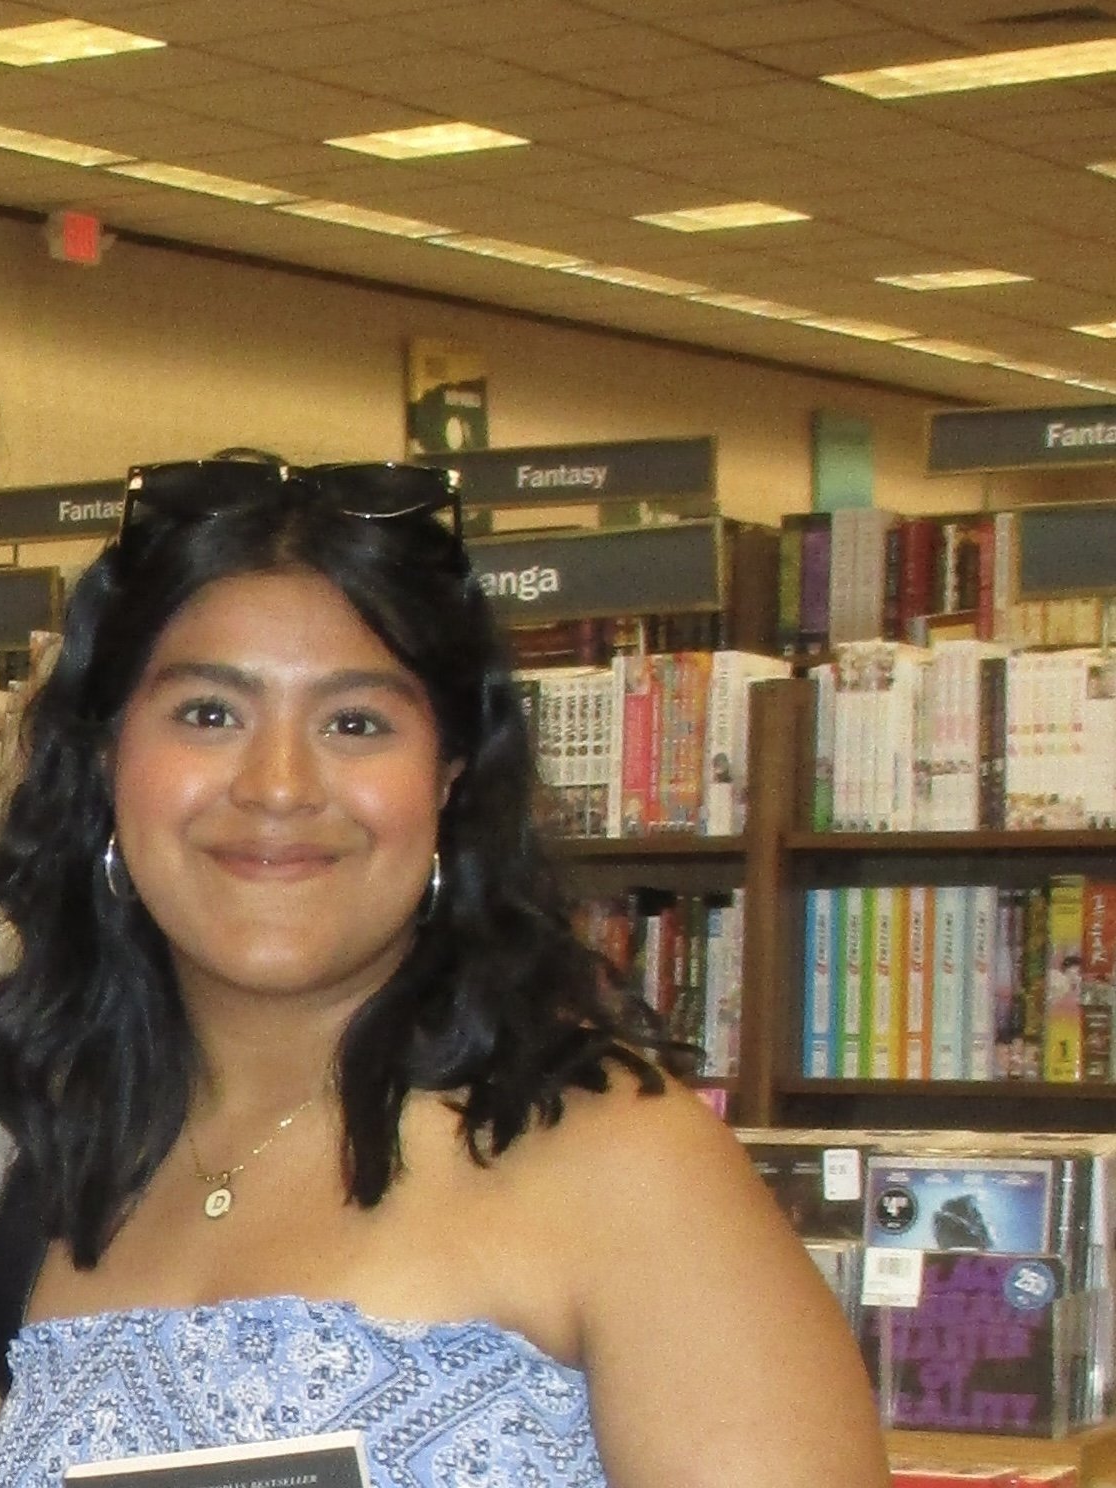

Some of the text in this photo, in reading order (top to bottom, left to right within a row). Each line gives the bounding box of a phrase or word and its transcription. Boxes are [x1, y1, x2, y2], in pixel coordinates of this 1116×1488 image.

[517, 464, 608, 489] Fantasy
[58, 499, 125, 522] Fantas
[476, 565, 560, 602] anga
